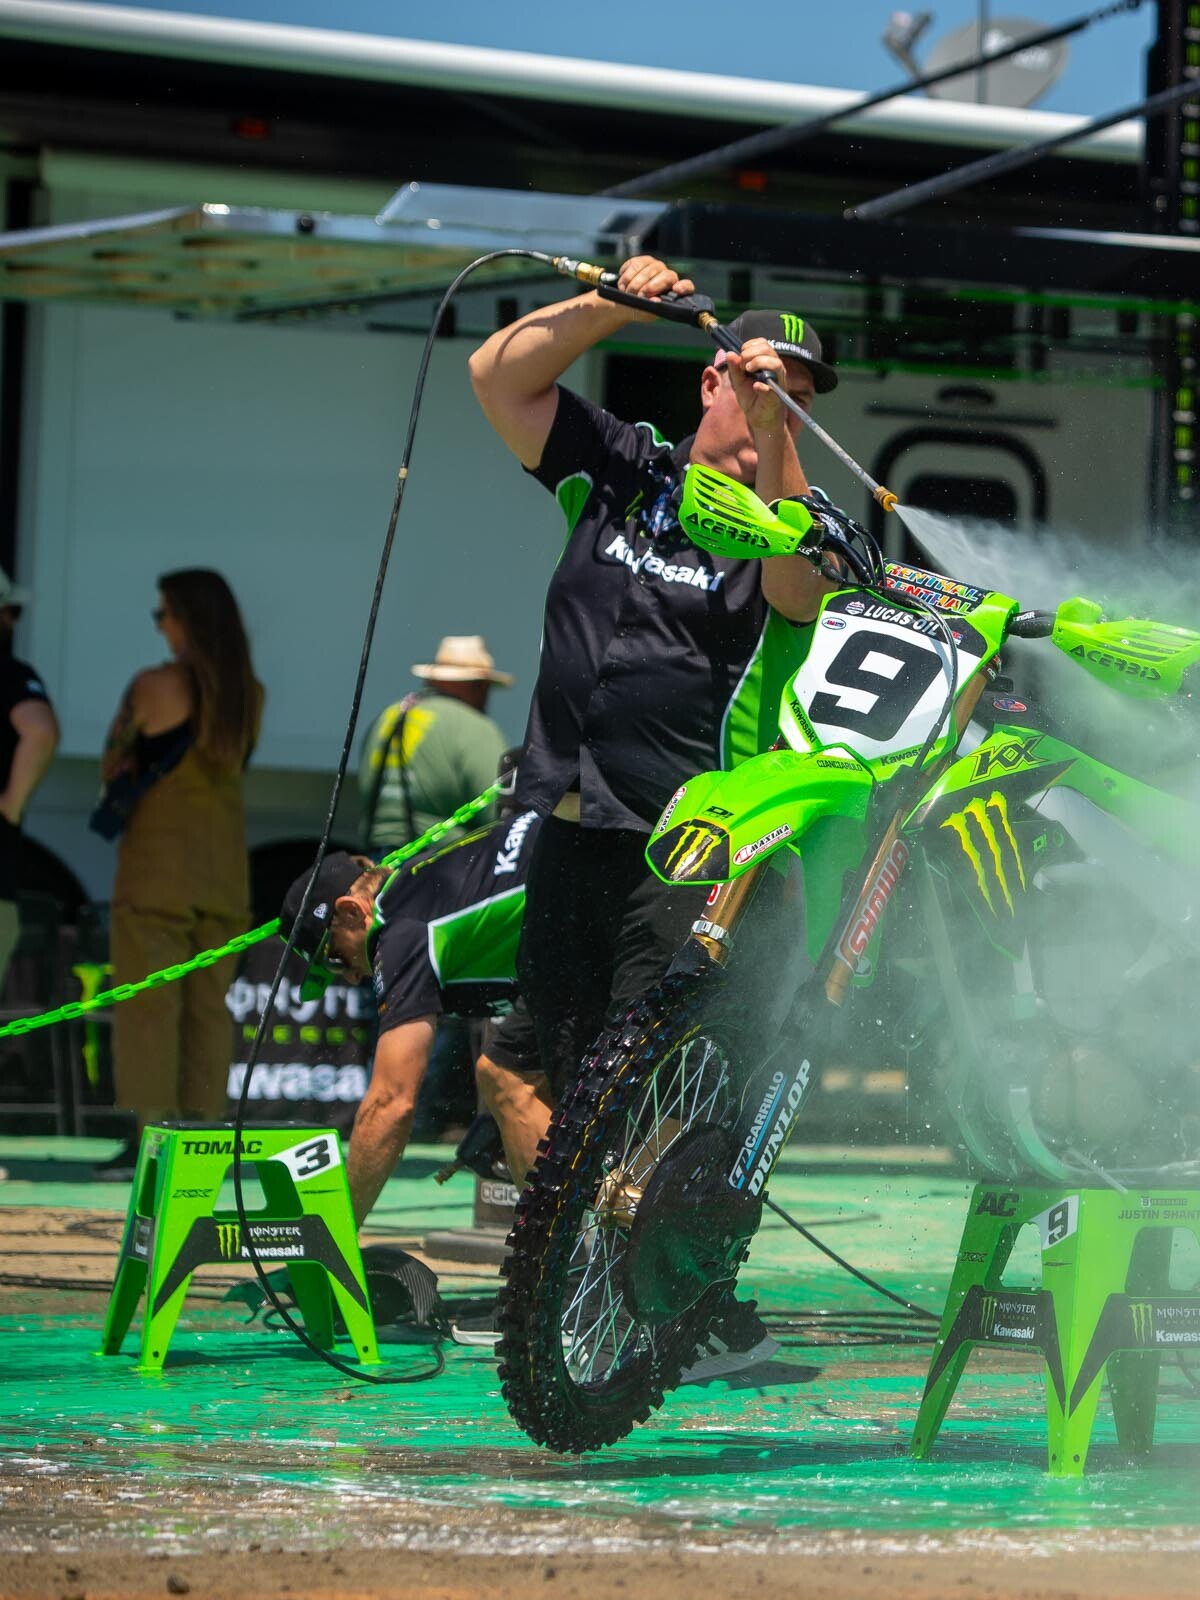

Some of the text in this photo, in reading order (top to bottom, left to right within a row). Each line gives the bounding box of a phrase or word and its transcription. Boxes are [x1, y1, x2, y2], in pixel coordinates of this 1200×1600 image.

[685, 512, 771, 549] ACERBIS
[878, 577, 973, 616] RENTHAL
[885, 563, 978, 602] RENTHAL
[864, 604, 913, 626] LUCAS
[913, 618, 940, 637] OIL
[1070, 644, 1161, 681] ACERBIS
[808, 629, 944, 742] 9
[790, 699, 816, 744] Kawasaki
[881, 742, 936, 767] Kawas
[968, 734, 1048, 782] KX
[750, 824, 790, 853] MAXIMA
[849, 840, 908, 956] SHOWA
[744, 1071, 784, 1150] CARRILLO
[748, 1059, 811, 1197] DUNLOP
[181, 1140, 263, 1156] TOMAC
[294, 1138, 331, 1177] 3
[975, 1191, 1020, 1217] AC
[1118, 1209, 1159, 1220] JUSTIN
[1047, 1201, 1069, 1246] 9
[241, 1244, 305, 1258] Kwasaki
[999, 1302, 1036, 1315] MONSTER
[993, 1323, 1035, 1340] Kawasaki
